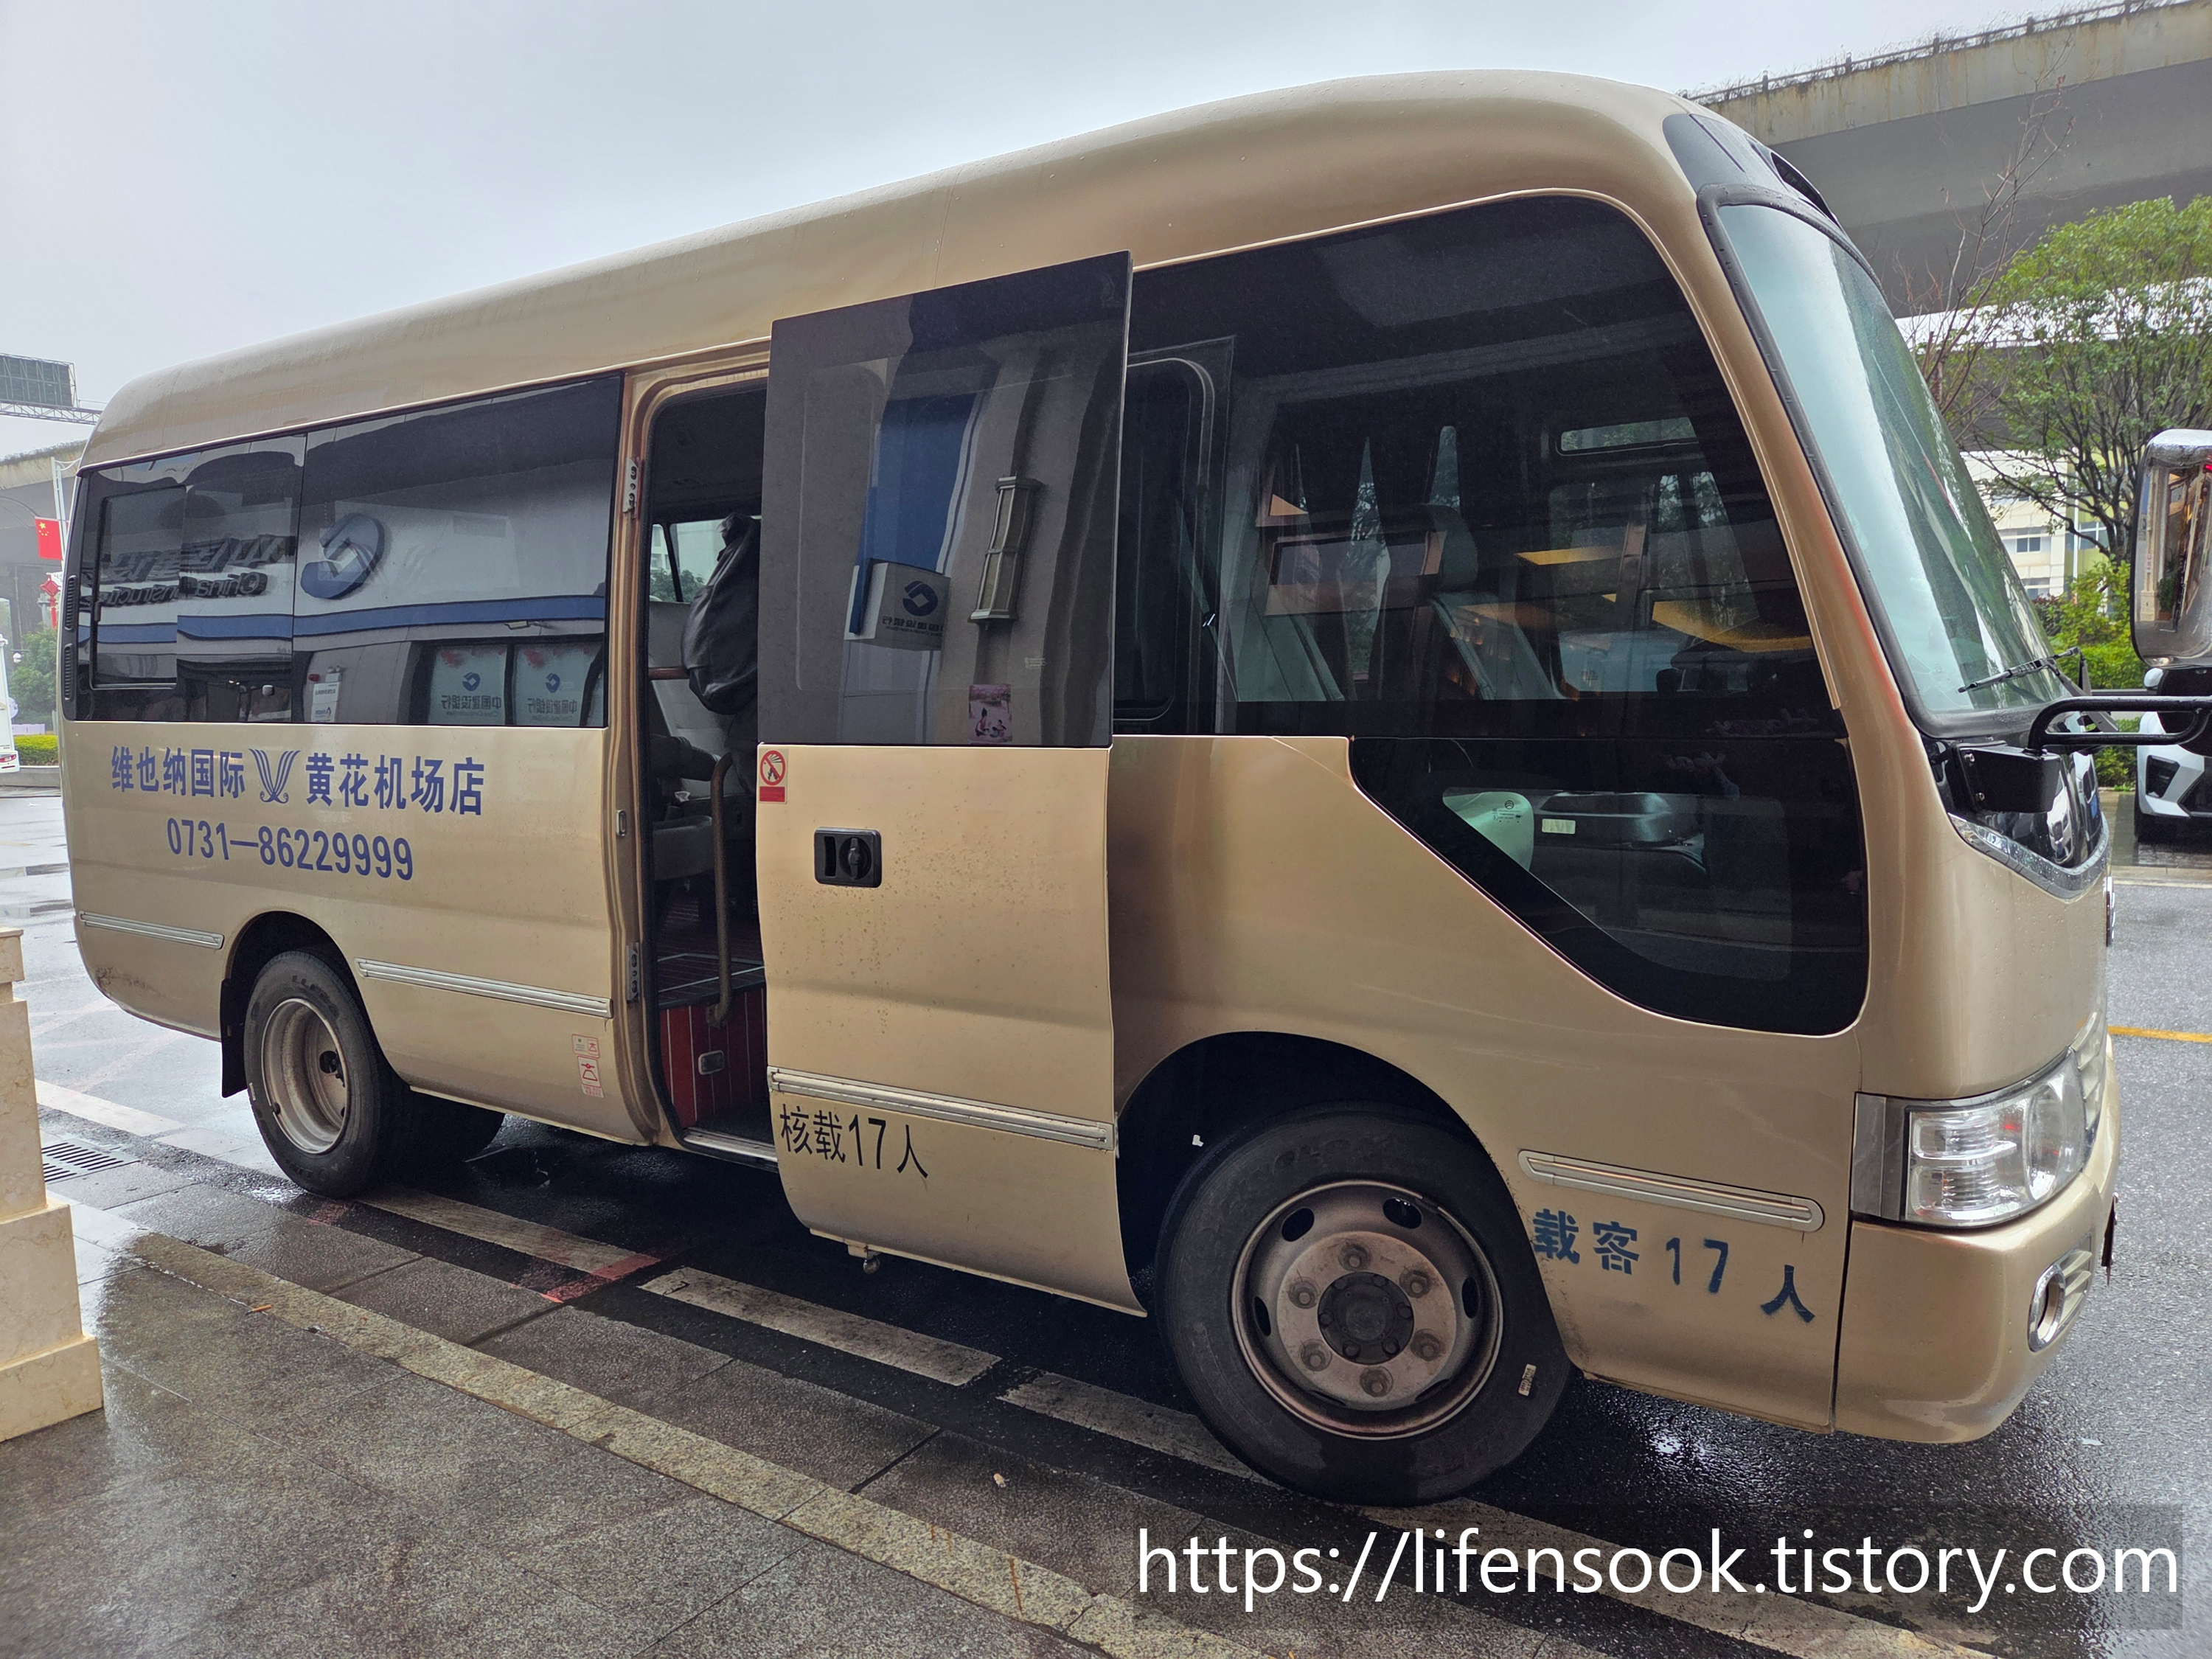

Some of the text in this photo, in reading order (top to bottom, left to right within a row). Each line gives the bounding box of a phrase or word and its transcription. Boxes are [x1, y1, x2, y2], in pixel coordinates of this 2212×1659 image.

[111, 745, 485, 816] 维也纳国际 黄花机场店
[779, 1103, 929, 1179] 核载17人
